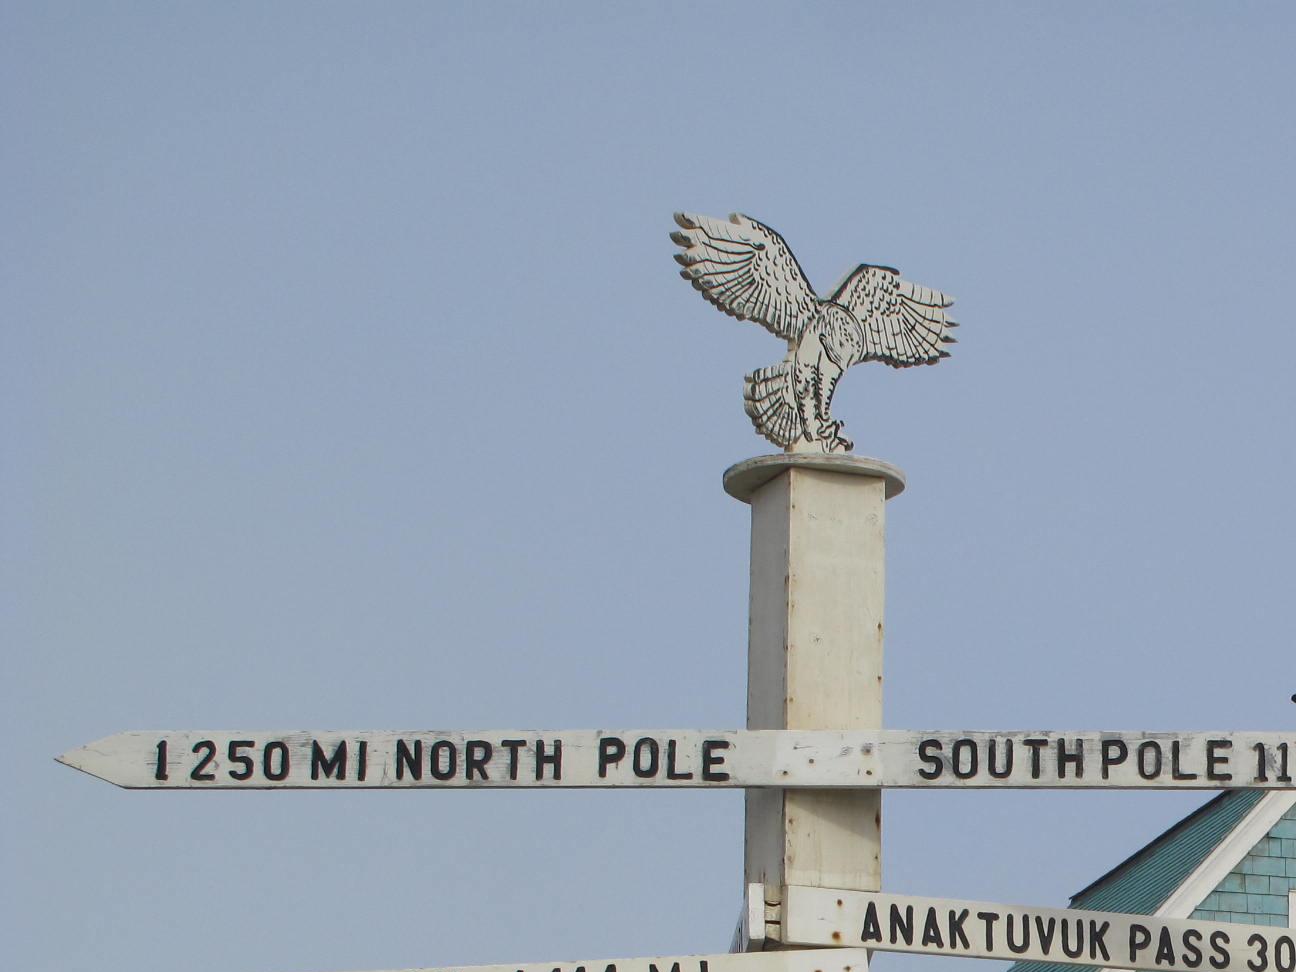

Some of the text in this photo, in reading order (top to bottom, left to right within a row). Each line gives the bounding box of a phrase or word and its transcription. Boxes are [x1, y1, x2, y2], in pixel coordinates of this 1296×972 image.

[154, 737, 731, 782] 1250 MI NORTH POLE
[918, 737, 1085, 781] SOUTH
[1101, 739, 1233, 782] POLE
[860, 900, 1112, 962] ANAKTUVUK
[1128, 923, 1232, 970] PASS
